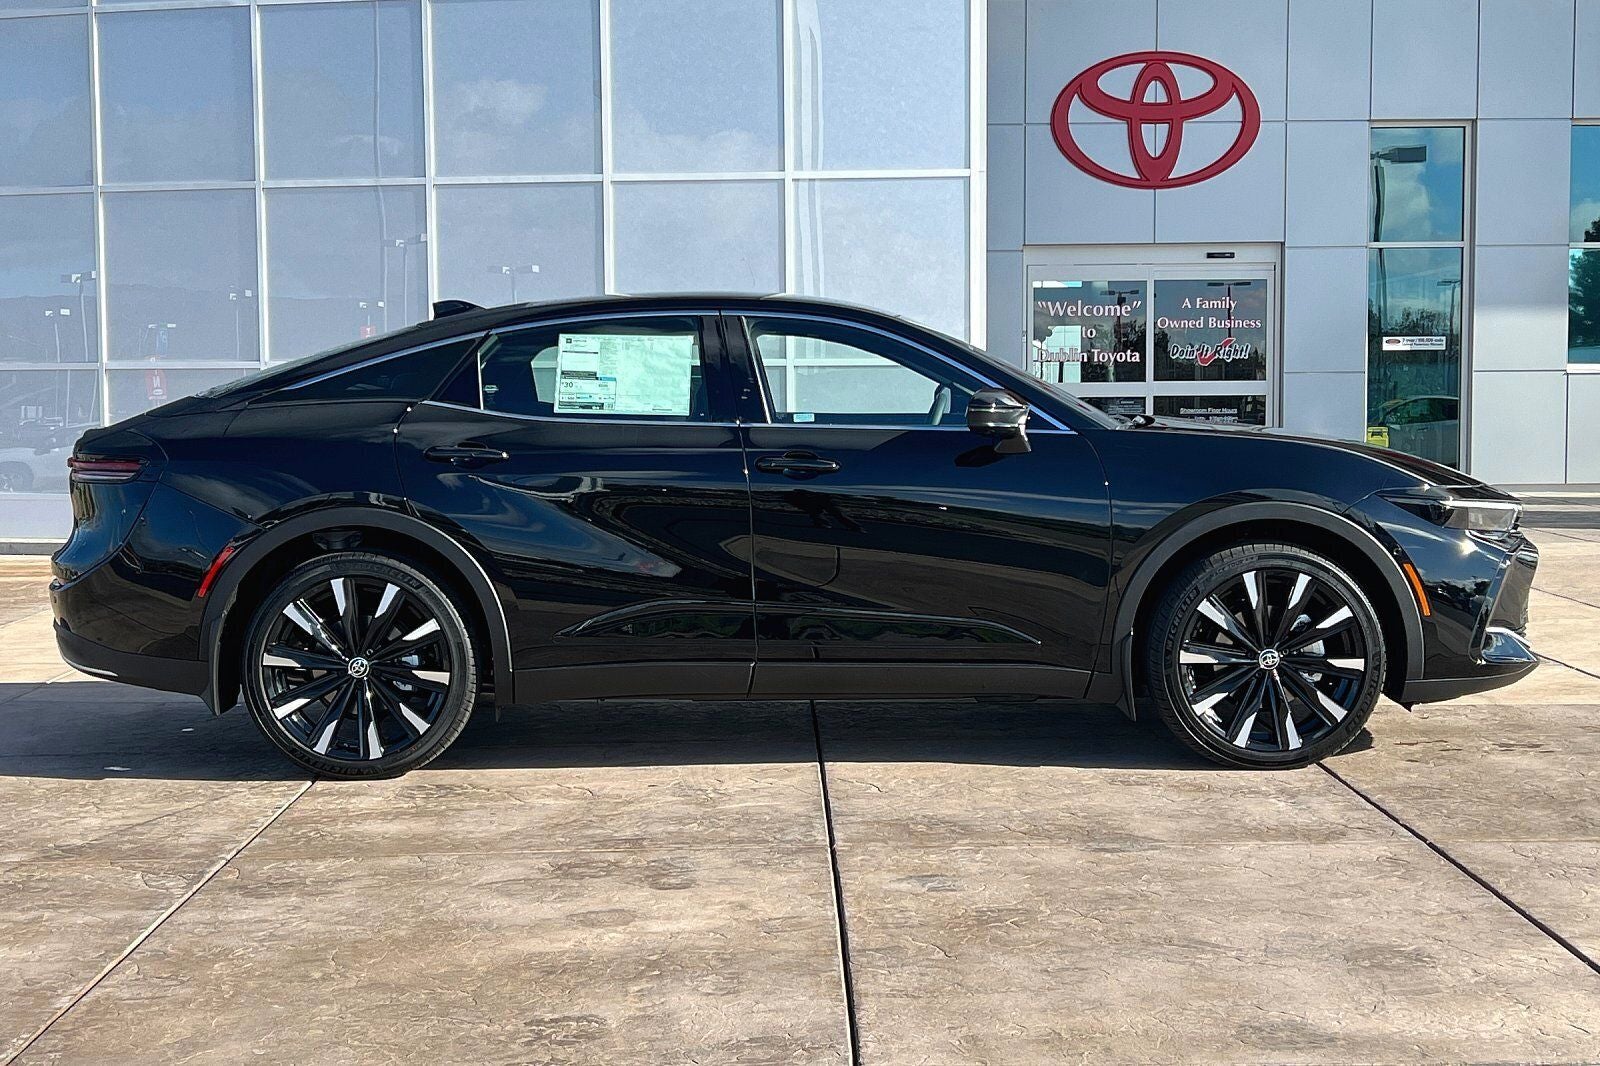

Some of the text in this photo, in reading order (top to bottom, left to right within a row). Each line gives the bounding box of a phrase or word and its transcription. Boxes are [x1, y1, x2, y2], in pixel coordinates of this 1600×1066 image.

[1181, 296, 1238, 313] A Family
[1157, 317, 1262, 329] Owned Business
[1081, 327, 1097, 338] to
[1037, 348, 1141, 366] Dublin Toyota
[1214, 343, 1251, 362] Right!
[1165, 586, 1201, 657] MICHELIN
